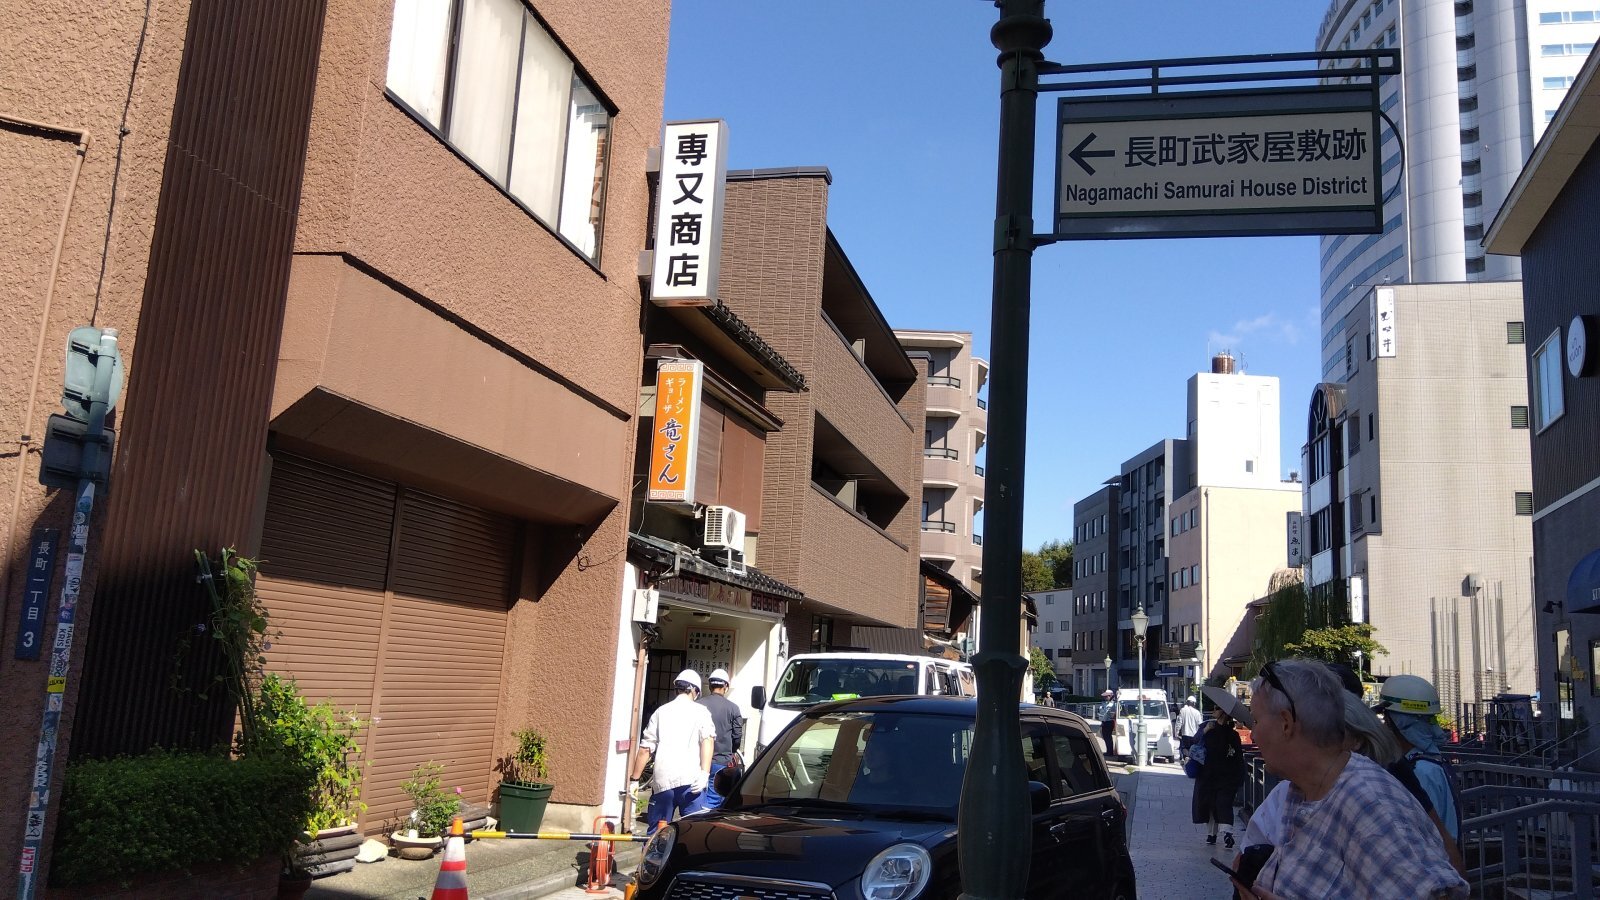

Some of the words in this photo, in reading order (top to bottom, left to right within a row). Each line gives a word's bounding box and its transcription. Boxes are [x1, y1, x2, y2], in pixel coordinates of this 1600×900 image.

[1124, 128, 1367, 168] 長町武家屋敷跡
[1066, 182, 1159, 205] Nagamachi
[1163, 180, 1235, 199] Samurai
[1240, 179, 1297, 197] House
[1302, 176, 1368, 196] District
[665, 133, 709, 287] 専又商店
[662, 377, 675, 415] ギョーザ
[675, 377, 687, 414] ラーメン
[658, 418, 683, 484] 竜さん
[27, 541, 51, 620] 長町一丁目
[23, 631, 35, 648] 3
[56, 628, 67, 647] KRIS
